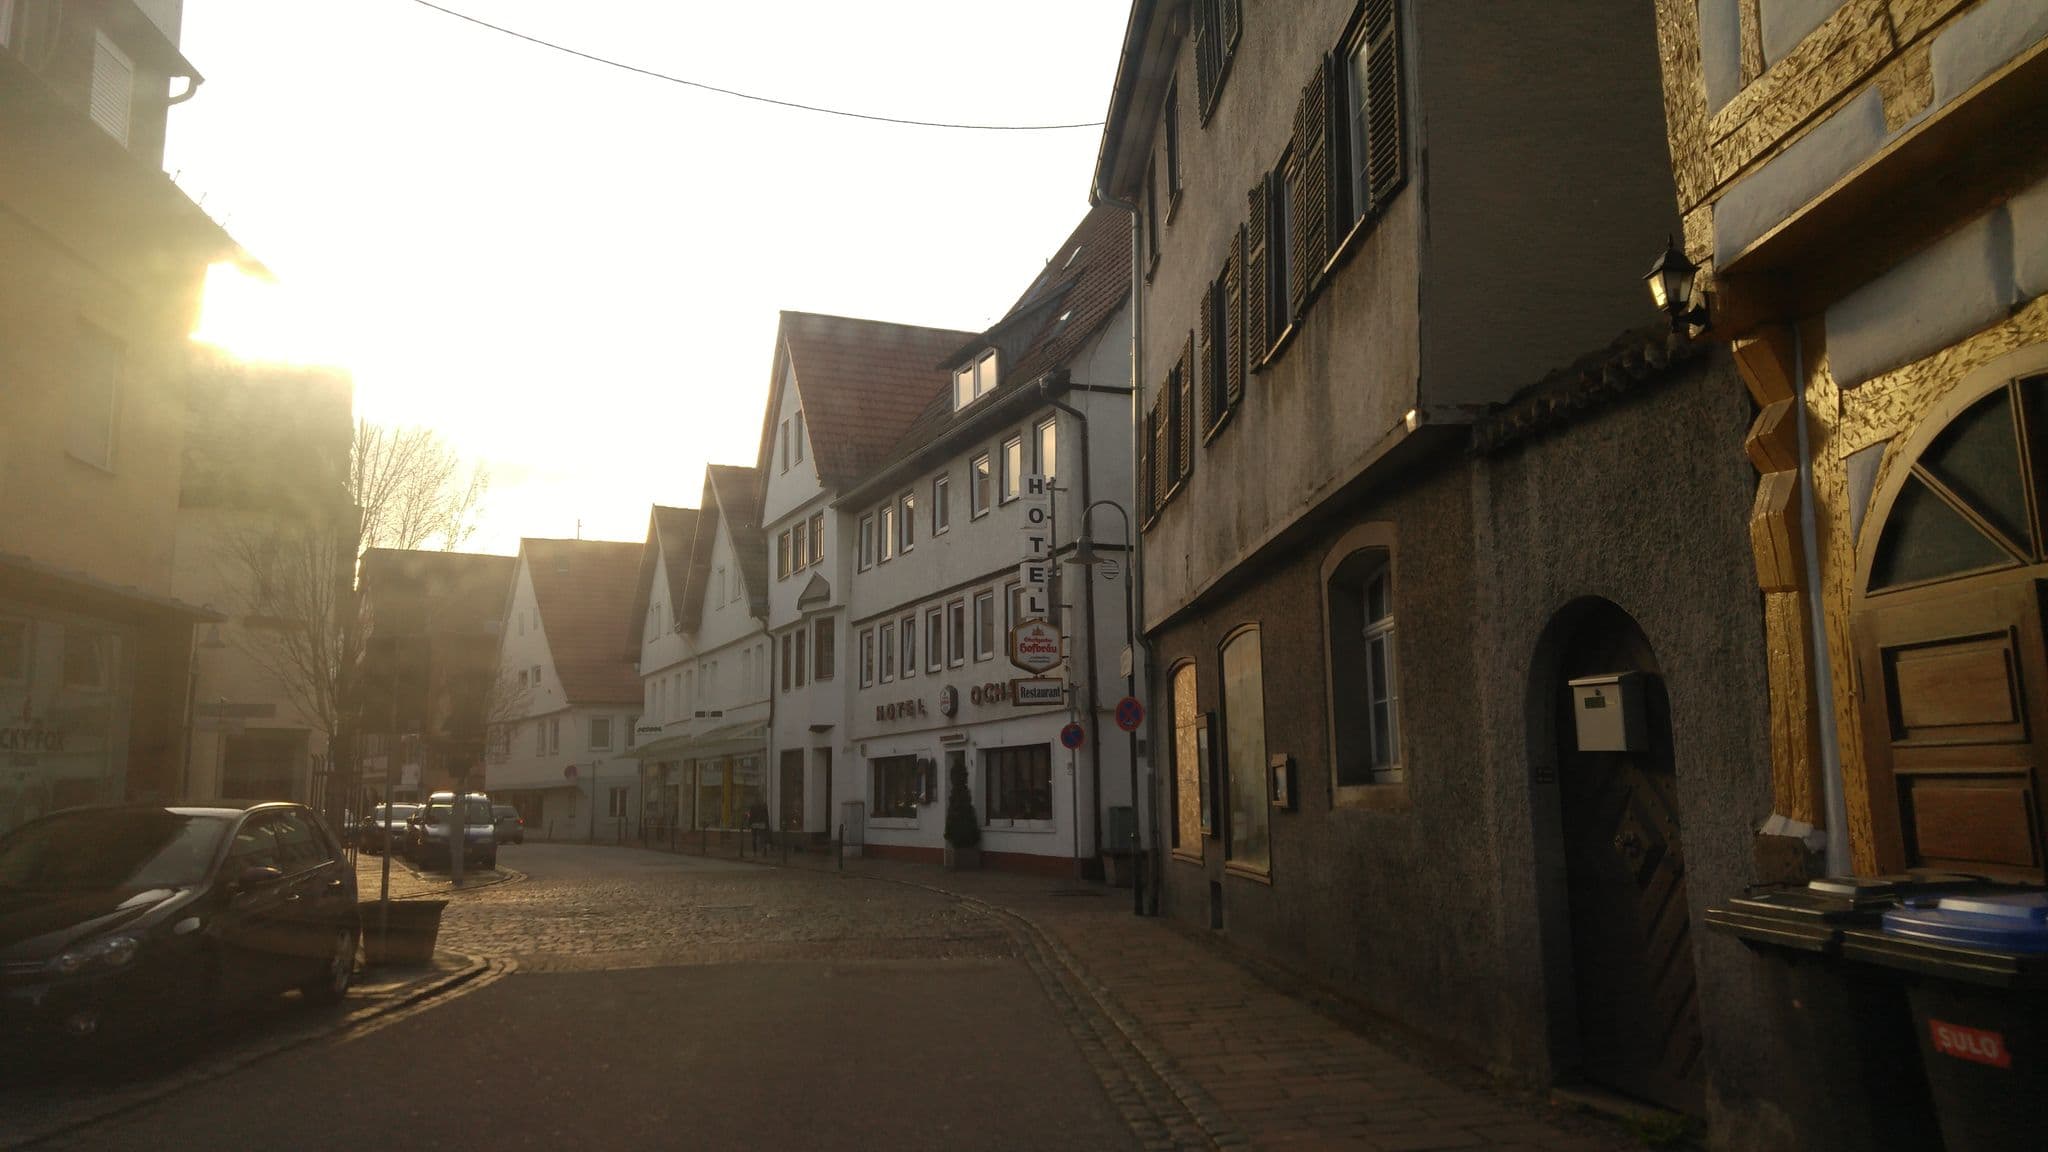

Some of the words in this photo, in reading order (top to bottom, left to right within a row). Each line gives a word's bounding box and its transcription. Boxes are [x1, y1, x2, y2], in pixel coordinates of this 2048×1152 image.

[1029, 478, 1045, 612] HOTEL
[1020, 686, 1061, 698] Restaurant
[876, 698, 928, 721] HOTEL
[1937, 1026, 1999, 1058] SULO
